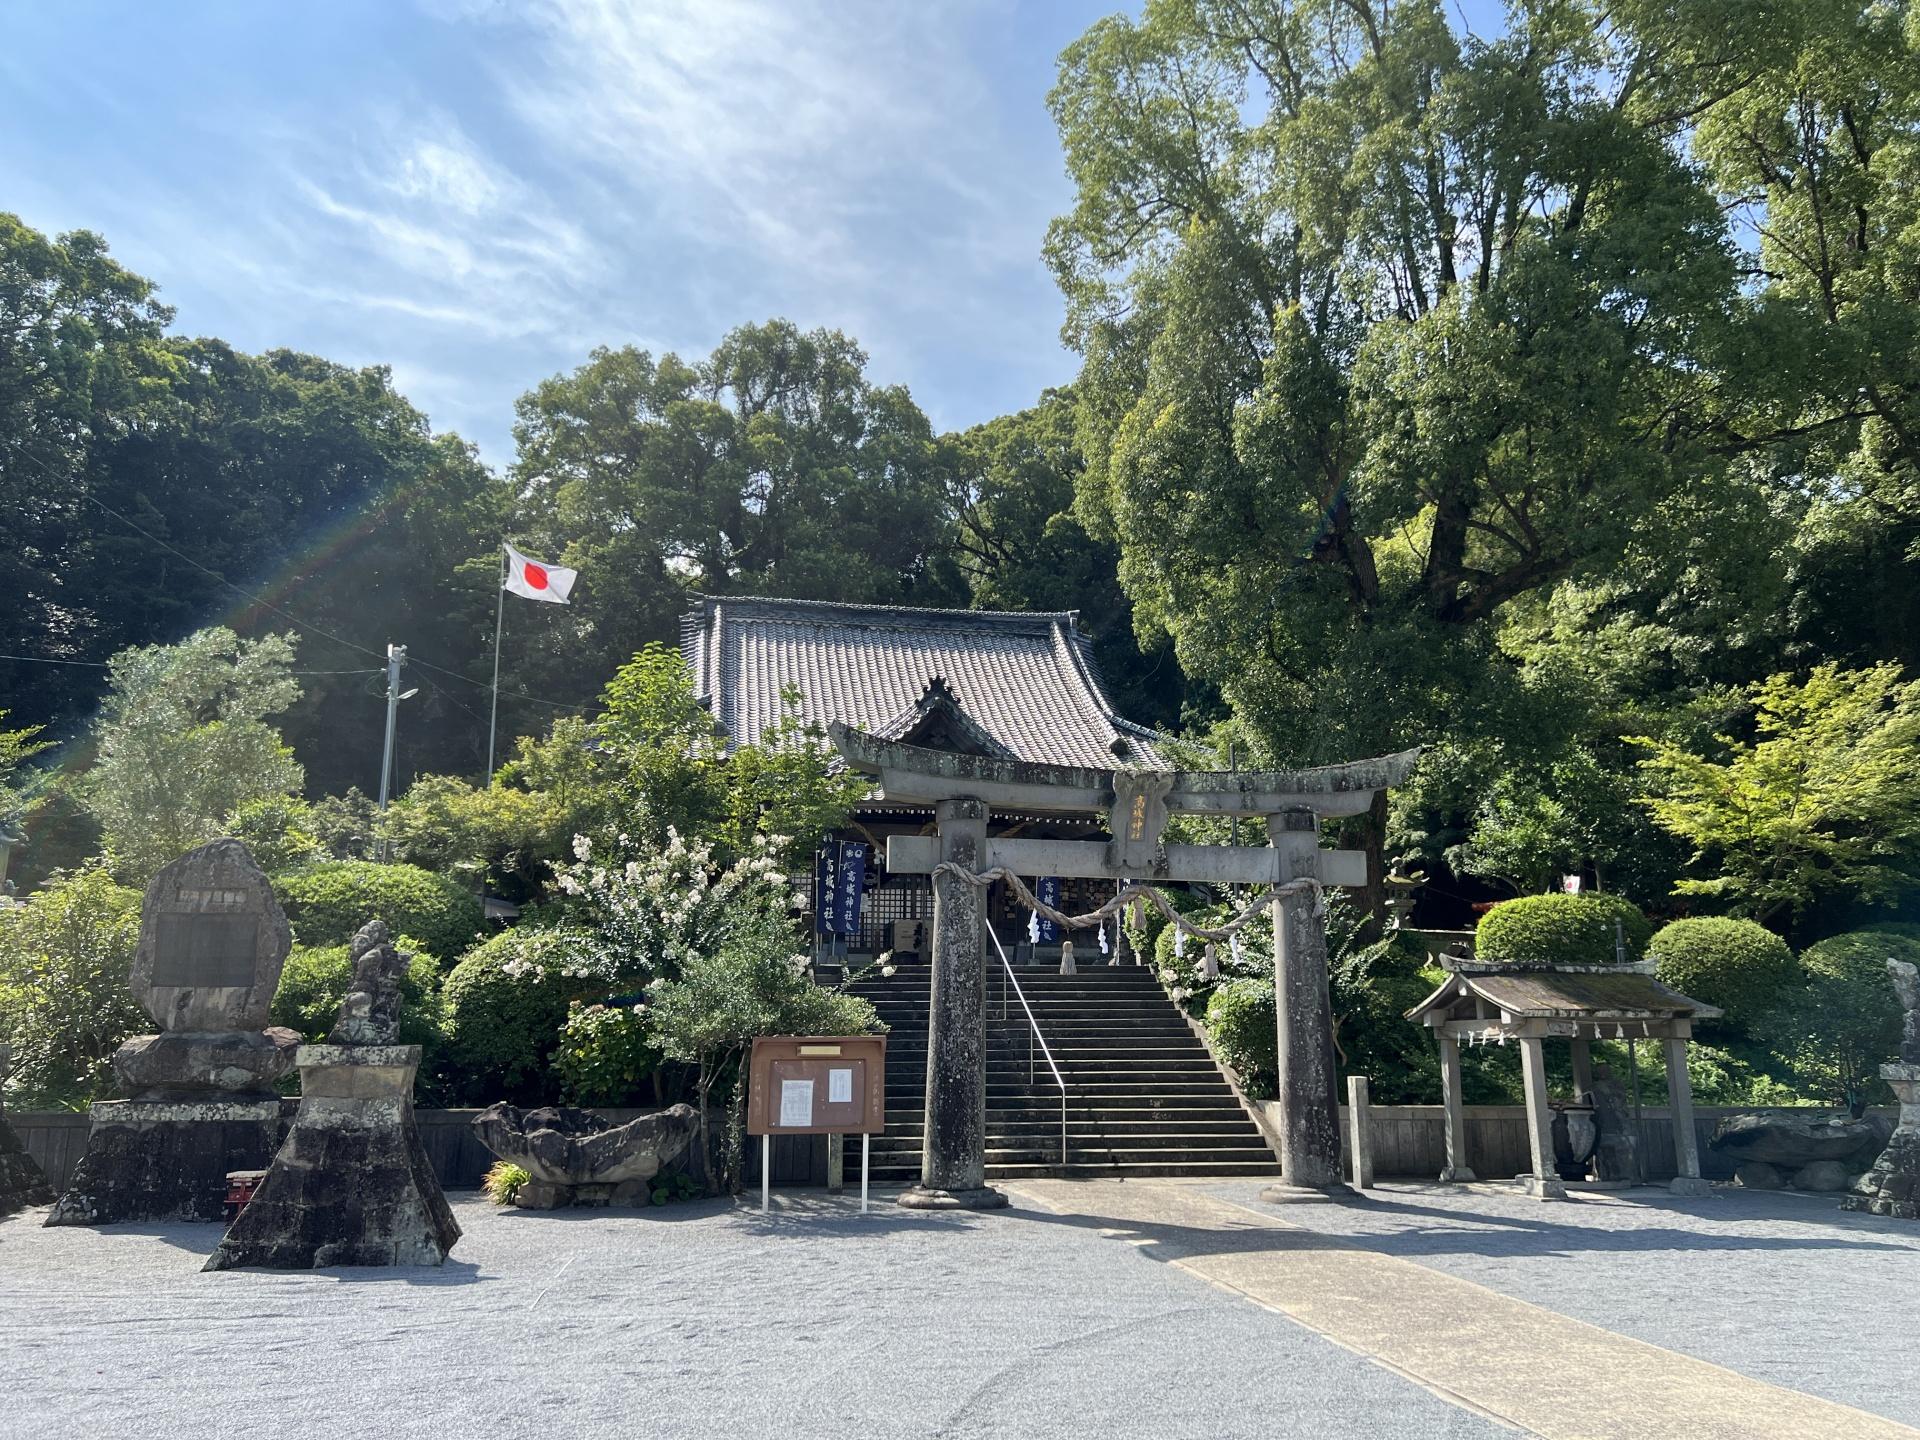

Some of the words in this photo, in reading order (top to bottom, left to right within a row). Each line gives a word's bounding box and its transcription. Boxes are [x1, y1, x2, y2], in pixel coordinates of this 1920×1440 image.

[823, 858, 835, 920] 高城神社
[844, 870, 857, 921] 高城神社
[1041, 881, 1054, 930] 高城社
